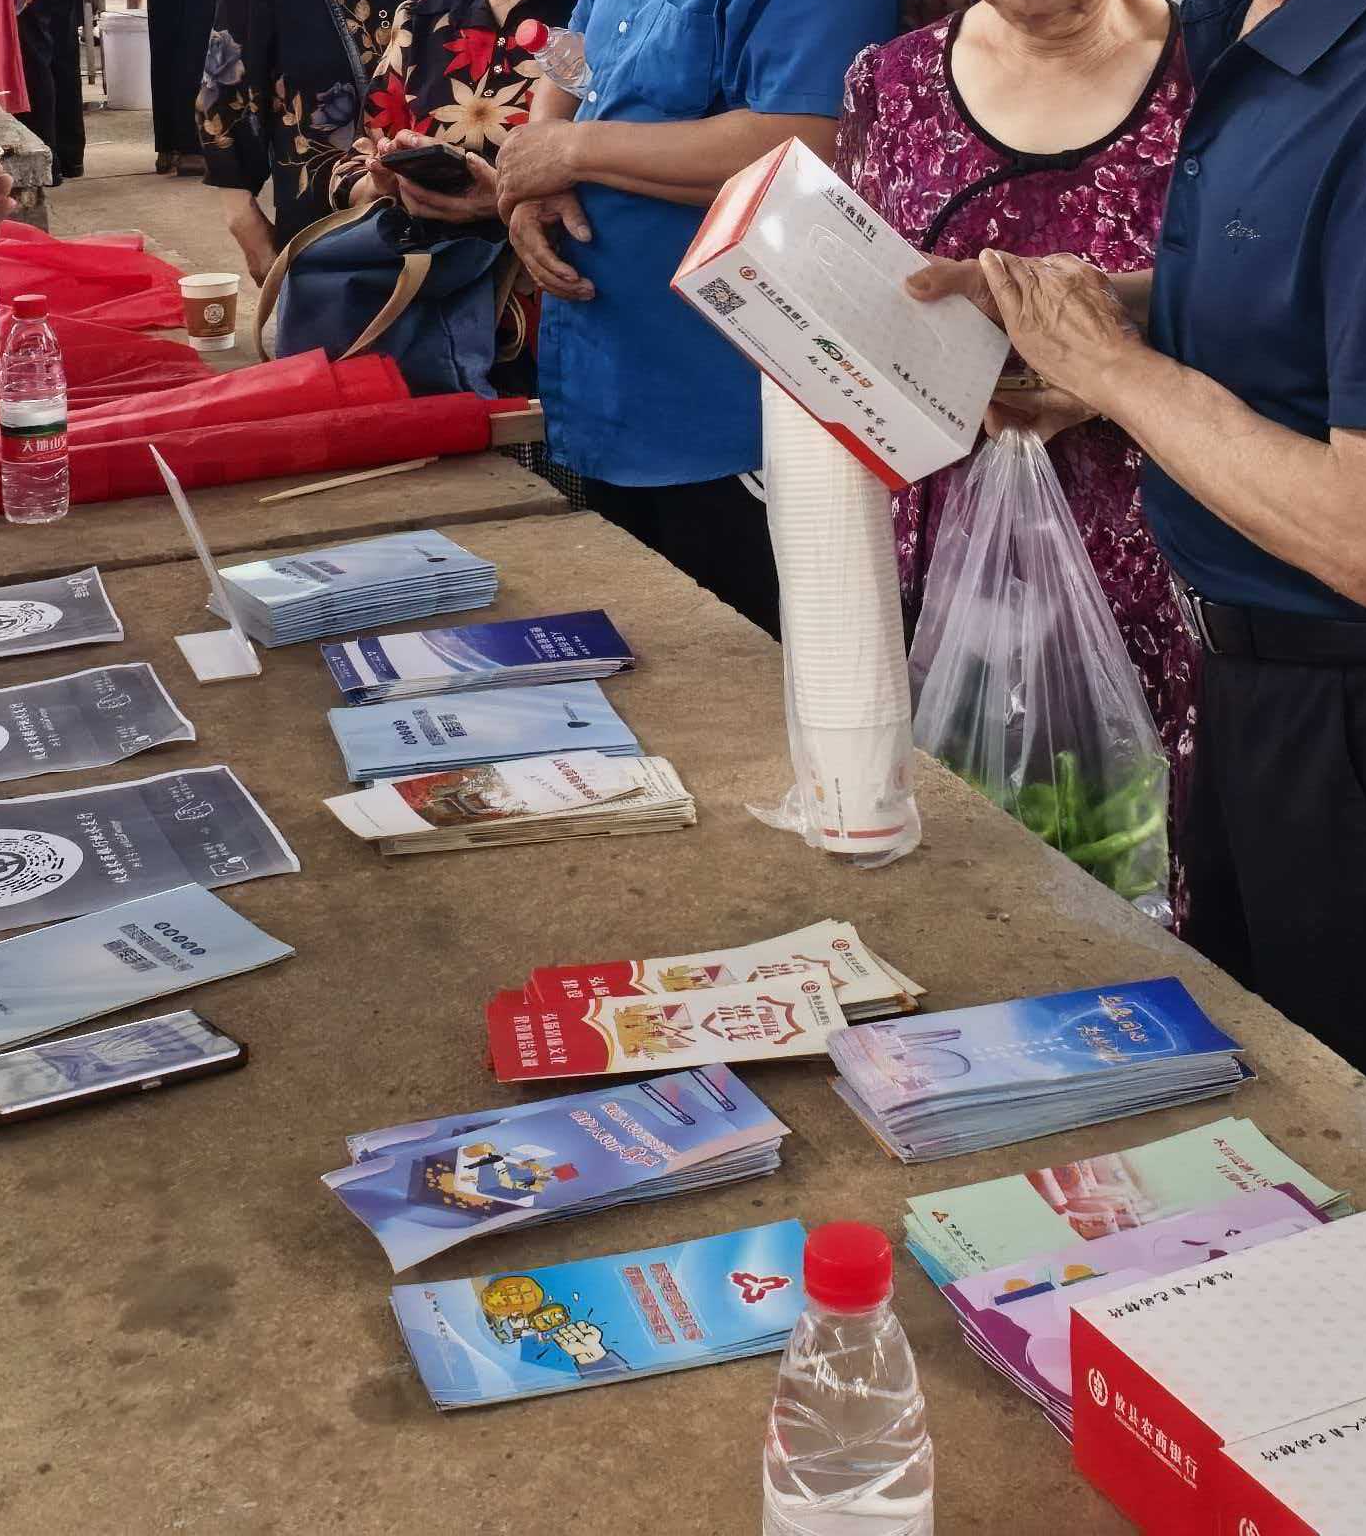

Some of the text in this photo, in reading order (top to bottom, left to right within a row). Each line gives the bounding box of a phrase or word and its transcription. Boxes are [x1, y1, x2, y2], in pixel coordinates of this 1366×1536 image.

[825, 185, 878, 241] 县农商银行
[1114, 1391, 1198, 1480] 攸县农商银行
